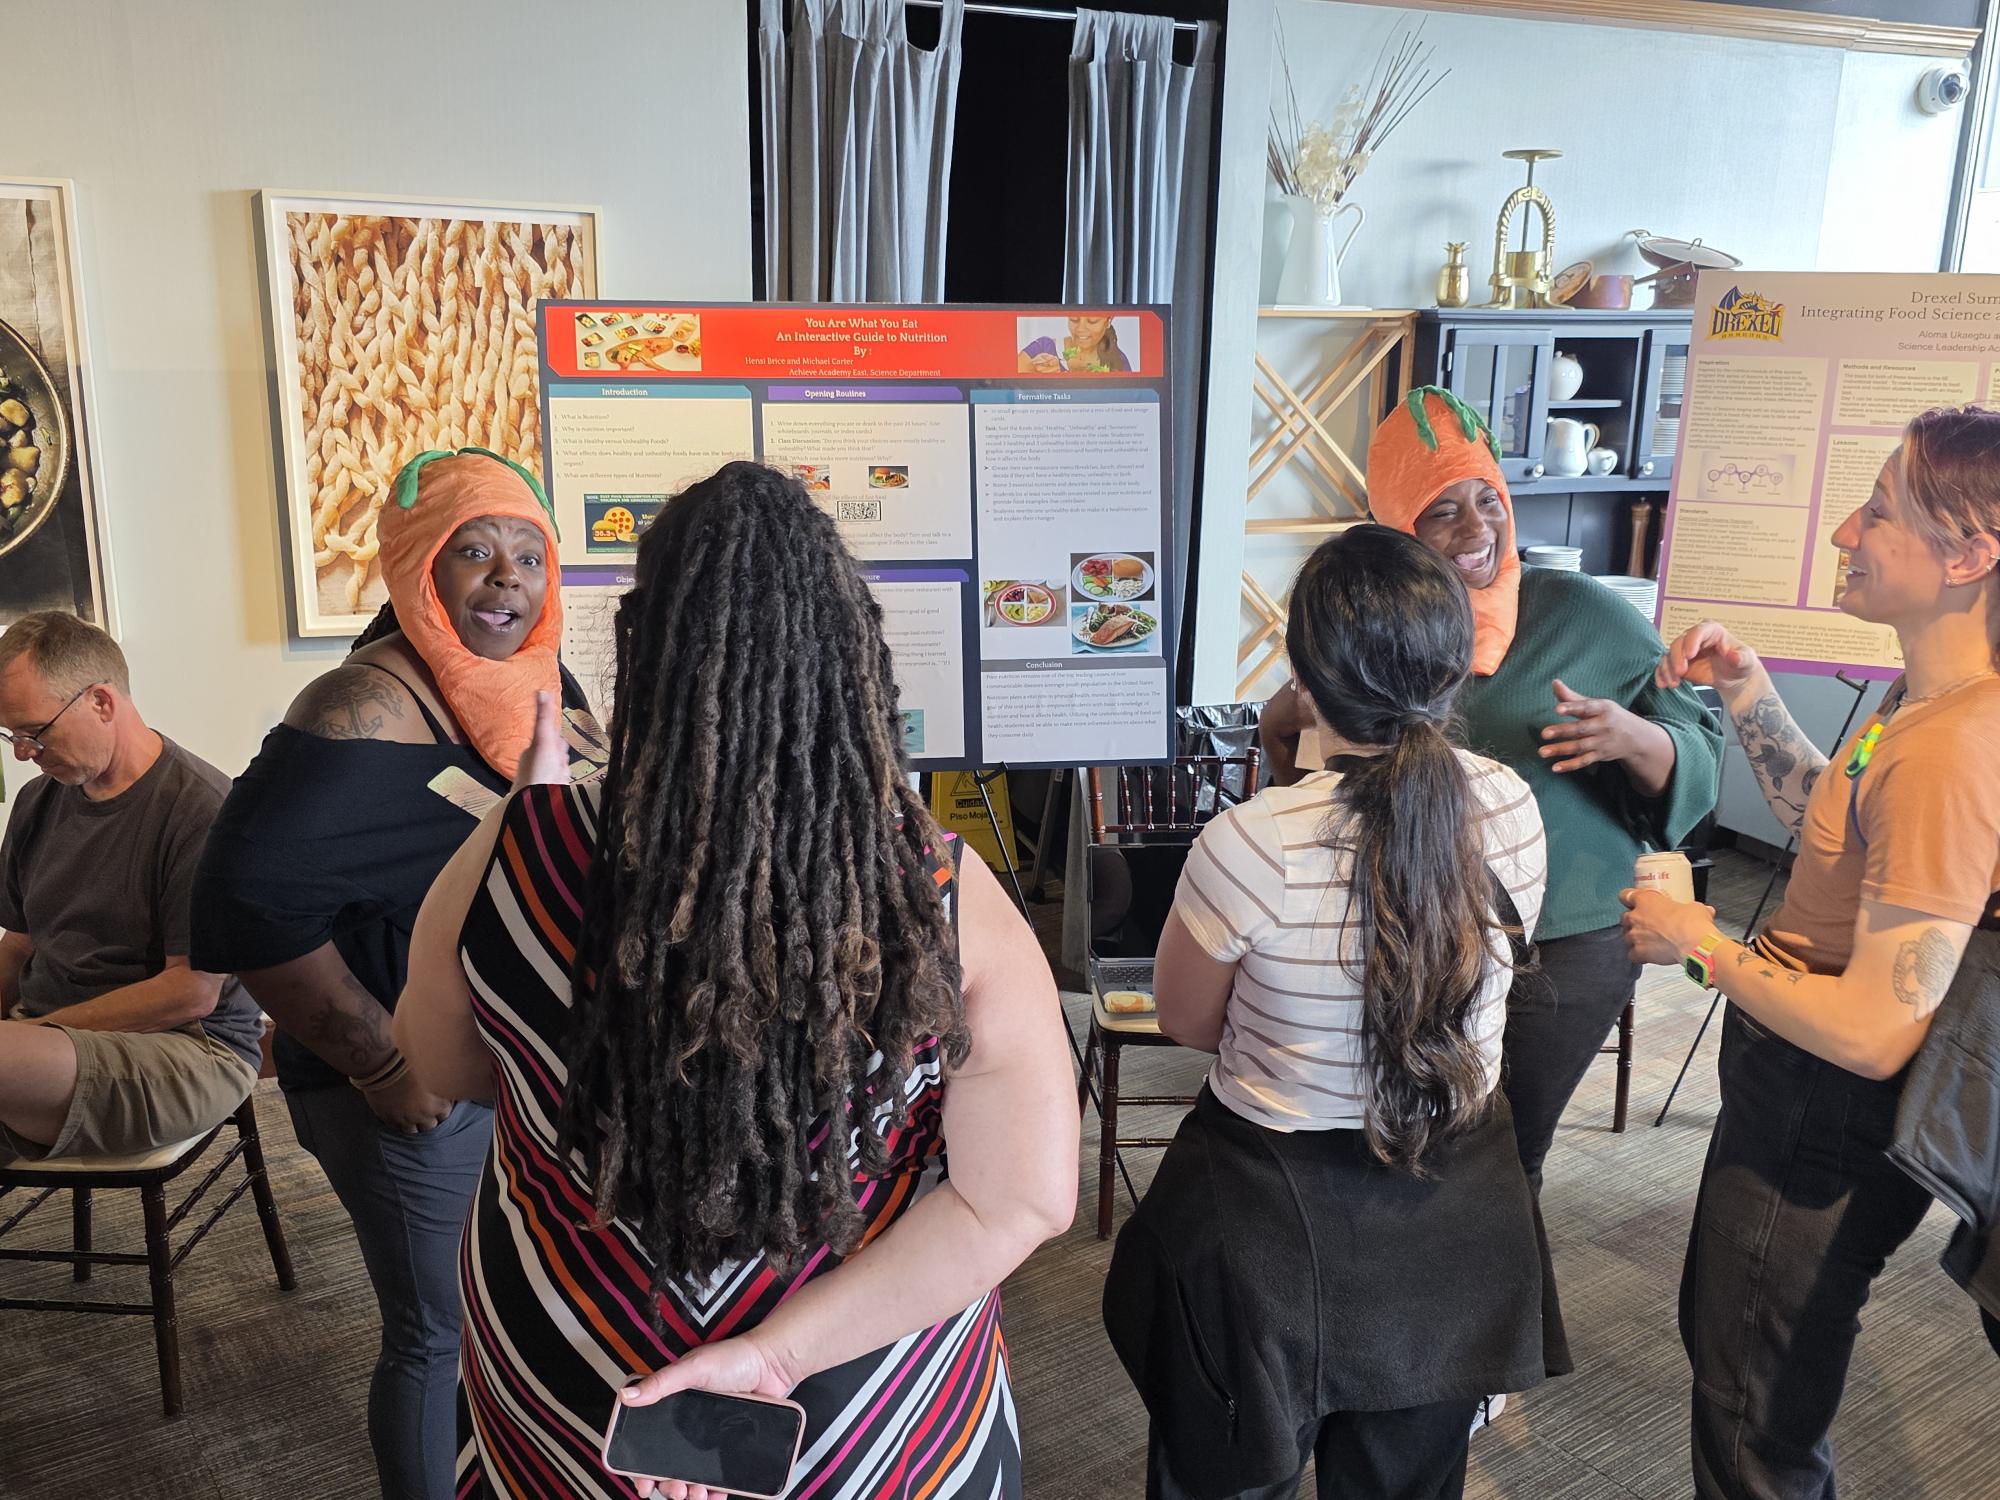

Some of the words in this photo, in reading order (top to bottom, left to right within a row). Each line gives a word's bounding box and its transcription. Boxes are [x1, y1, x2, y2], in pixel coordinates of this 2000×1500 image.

[1911, 291, 1962, 304] Drexel
[1966, 292, 2000, 305] Sum
[1800, 306, 1885, 321] Integrating
[1888, 307, 1926, 320] Food
[1931, 307, 1991, 321] Science
[805, 318, 825, 329] You
[827, 318, 846, 329] Are
[848, 318, 878, 329] What
[880, 318, 900, 329] You
[902, 318, 918, 329] Eat
[1712, 309, 1781, 336] DREXEL
[776, 332, 792, 342] An
[794, 332, 851, 342] Interactive
[854, 332, 885, 342] Guide
[886, 332, 897, 342] to
[900, 332, 948, 342] Nutrition
[1918, 330, 1948, 339] Aloma
[854, 346, 867, 357] By
[1897, 342, 1933, 351] Science
[1935, 343, 1985, 352] Leadership
[1987, 344, 2000, 352] Ac
[767, 357, 785, 366] Brice
[786, 357, 801, 366] and
[802, 357, 830, 366] Michael
[832, 357, 854, 366] Carter
[789, 369, 818, 377] Achieve
[818, 369, 852, 377] Academy
[870, 369, 897, 377] Science
[899, 369, 941, 377] Department
[602, 388, 648, 396] Introduction
[804, 390, 834, 399] Opening
[836, 390, 866, 398] Routines
[1018, 393, 1052, 401] Formative
[1053, 393, 1072, 401] Tasks
[950, 813, 968, 821] Piso
[969, 811, 998, 820] Mojao
